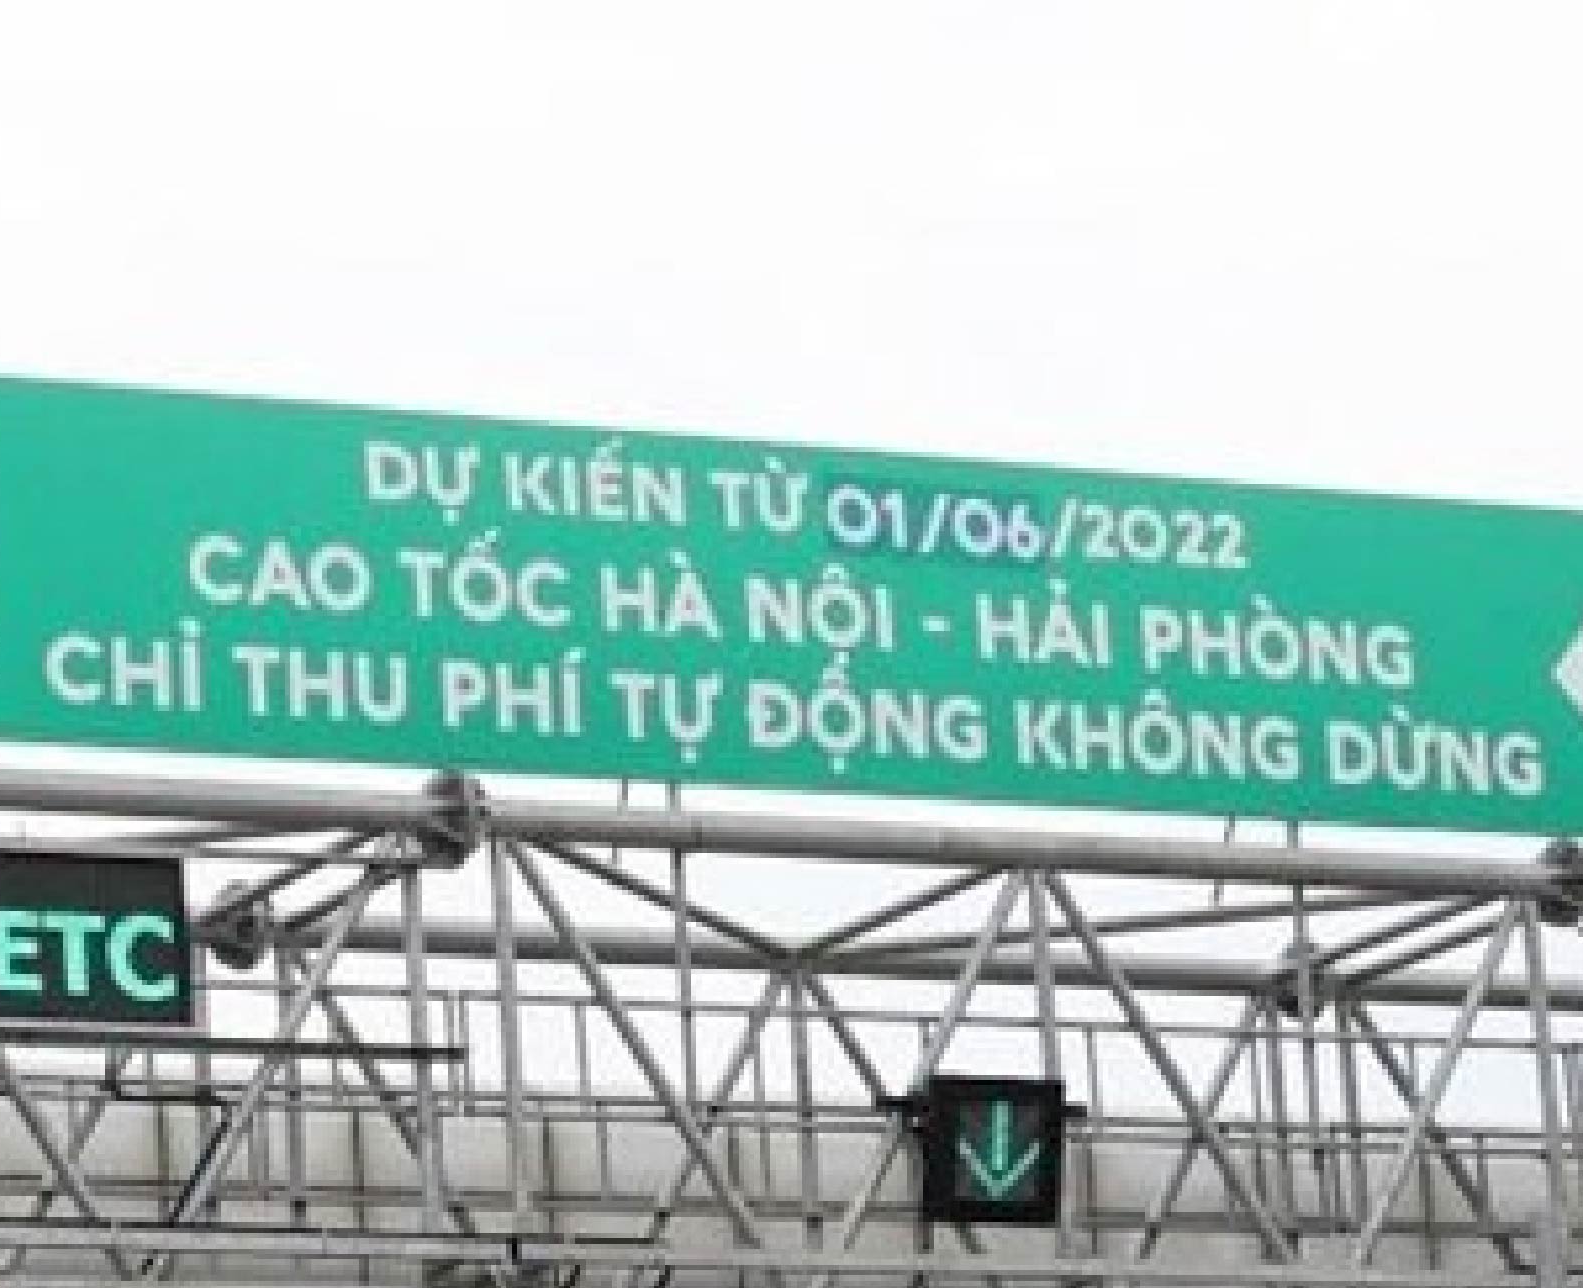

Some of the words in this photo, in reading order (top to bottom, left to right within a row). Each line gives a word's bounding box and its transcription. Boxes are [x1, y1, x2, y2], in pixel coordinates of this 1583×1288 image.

[364, 439, 479, 525] DỰ
[503, 433, 686, 528] KIẾN
[711, 456, 807, 533] TỪ
[826, 486, 1248, 570] 01/06/2022
[188, 534, 373, 611] CAO
[398, 527, 570, 626] TỐC
[598, 548, 720, 643] HÀ
[746, 560, 894, 660] NỘI
[975, 578, 1113, 668] HẢI
[1140, 594, 1415, 690] PHÒNG
[44, 617, 203, 713] CHỈ
[233, 645, 408, 724] THU
[439, 647, 586, 735] PHÍ
[609, 668, 721, 763] TỰ
[744, 665, 988, 775] ĐỘNG
[1014, 691, 1301, 783] KHÔNG
[1327, 707, 1545, 797] DỪNG
